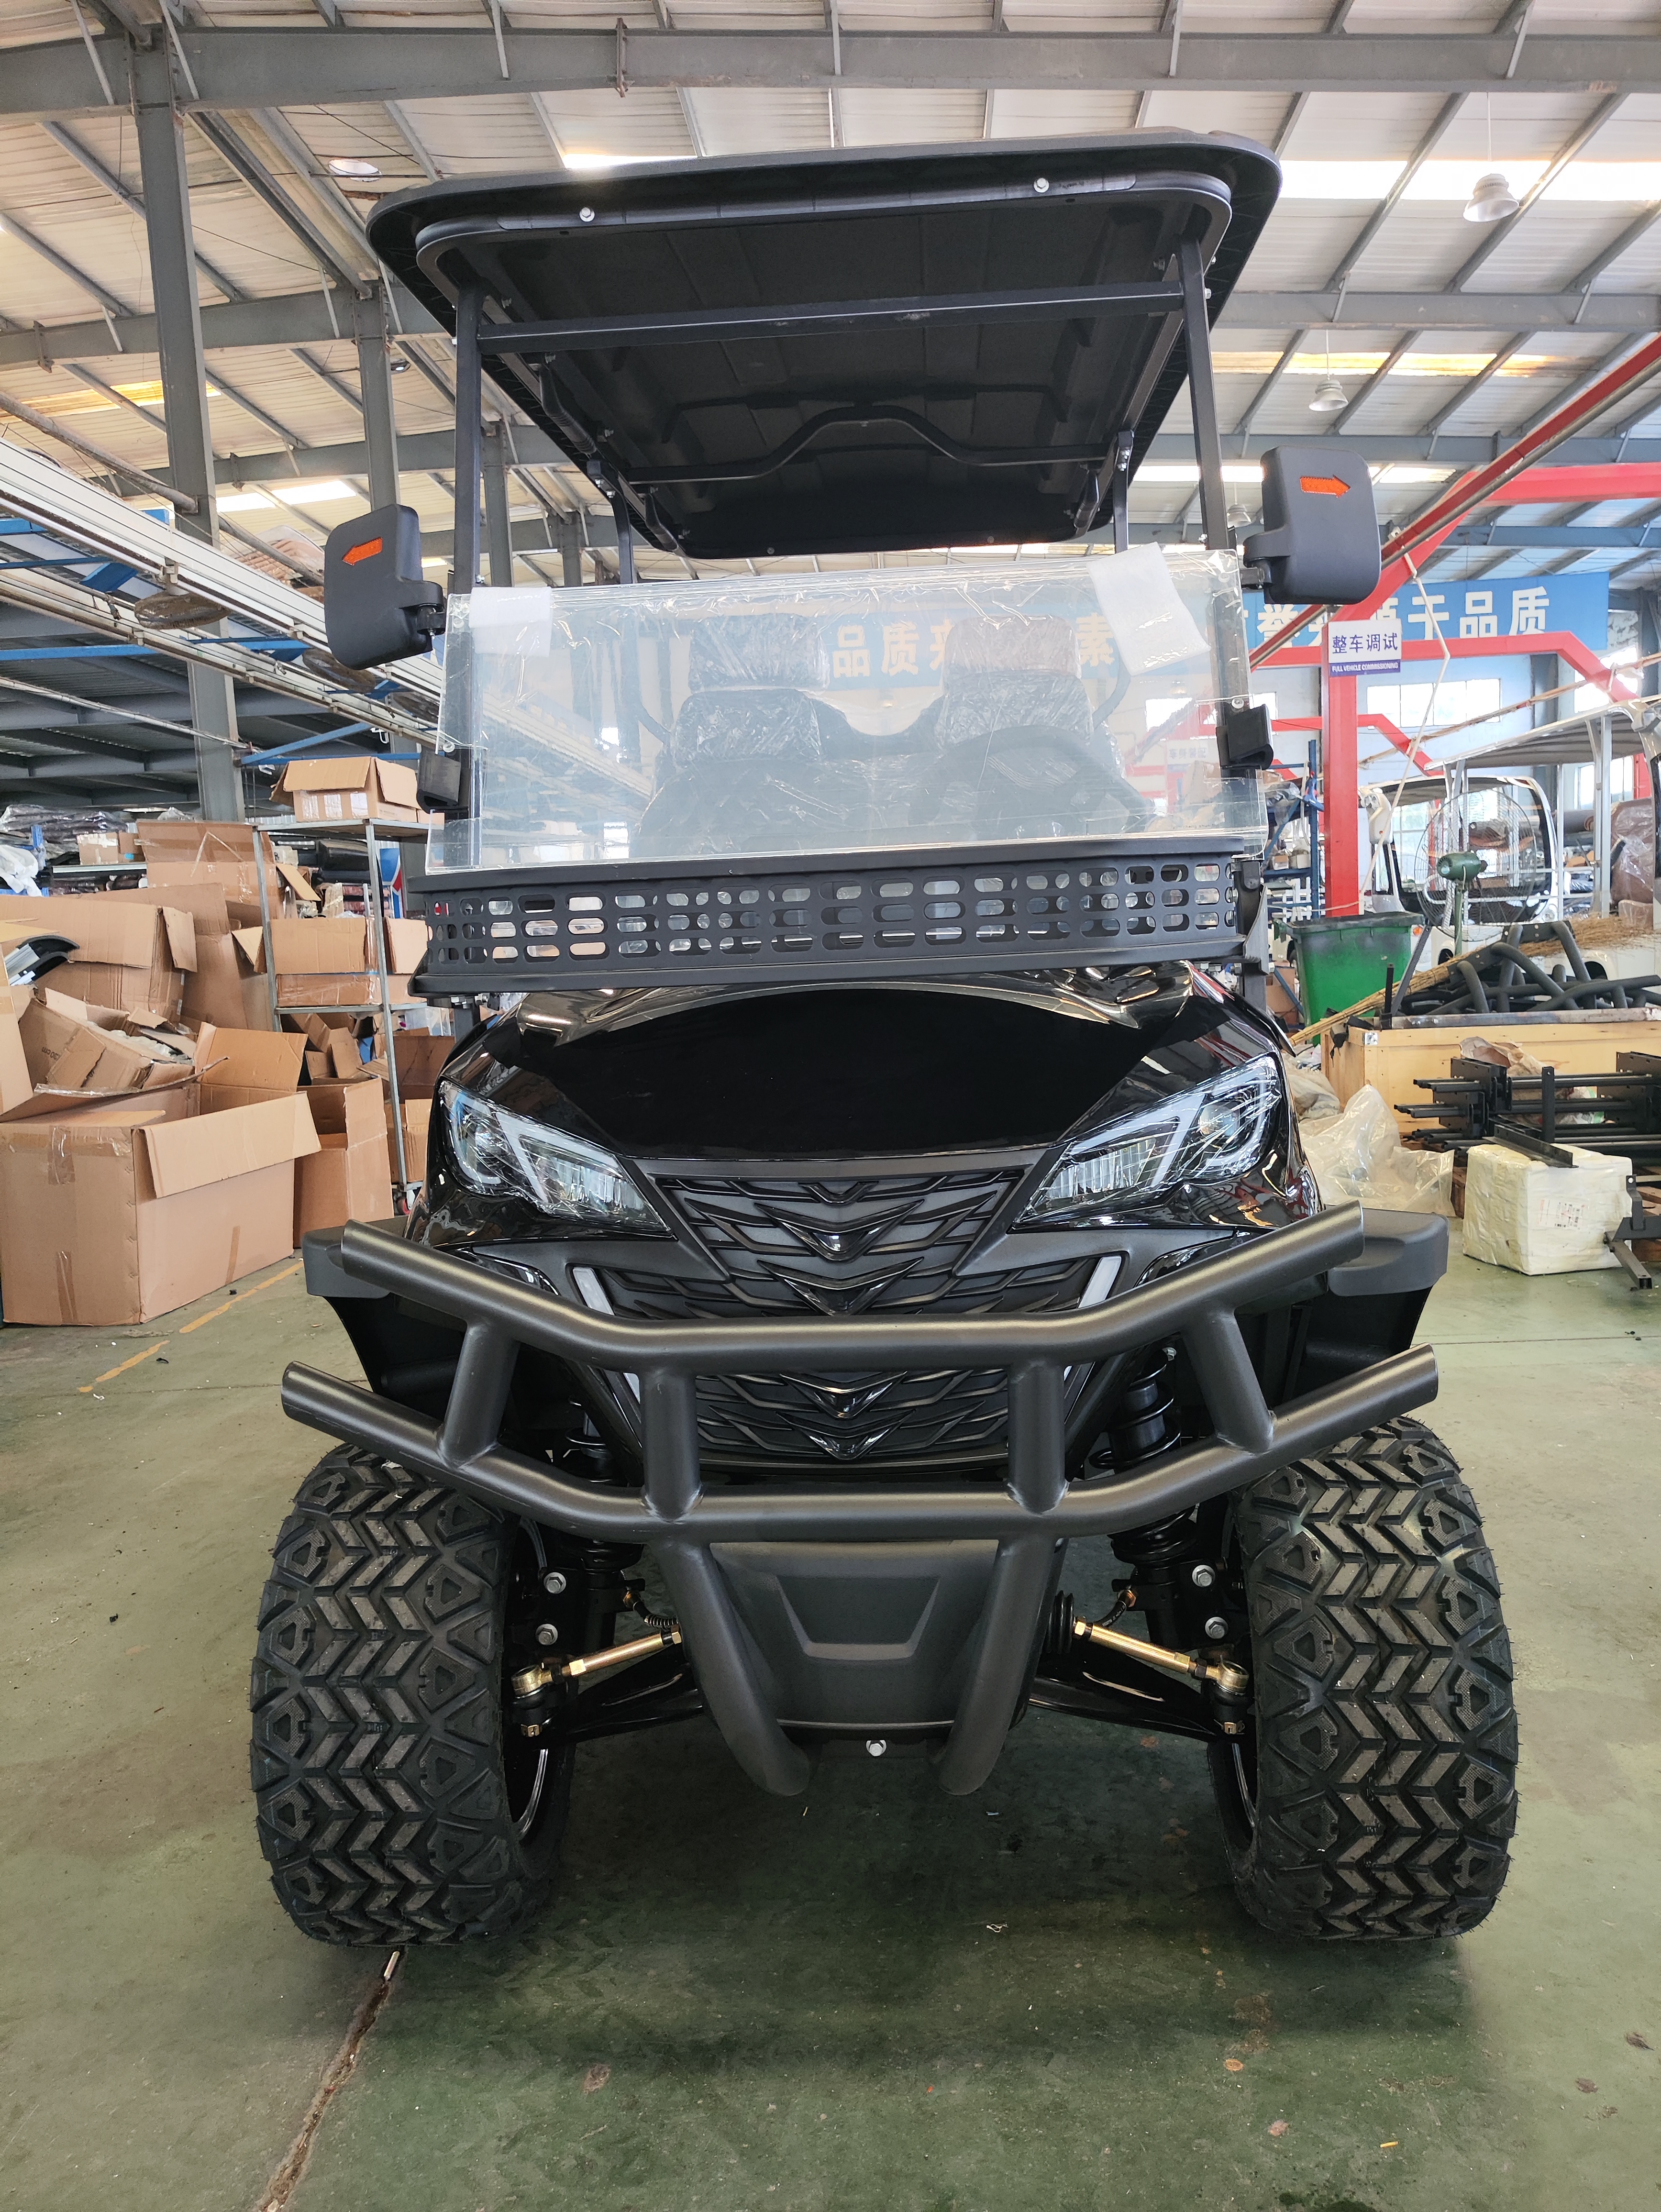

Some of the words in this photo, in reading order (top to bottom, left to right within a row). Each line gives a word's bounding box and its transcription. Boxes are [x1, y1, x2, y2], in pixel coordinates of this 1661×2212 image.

[1075, 612, 1115, 667] 素
[1332, 632, 1397, 653] 整车调试
[1362, 662, 1398, 670] COMMISSIONING
